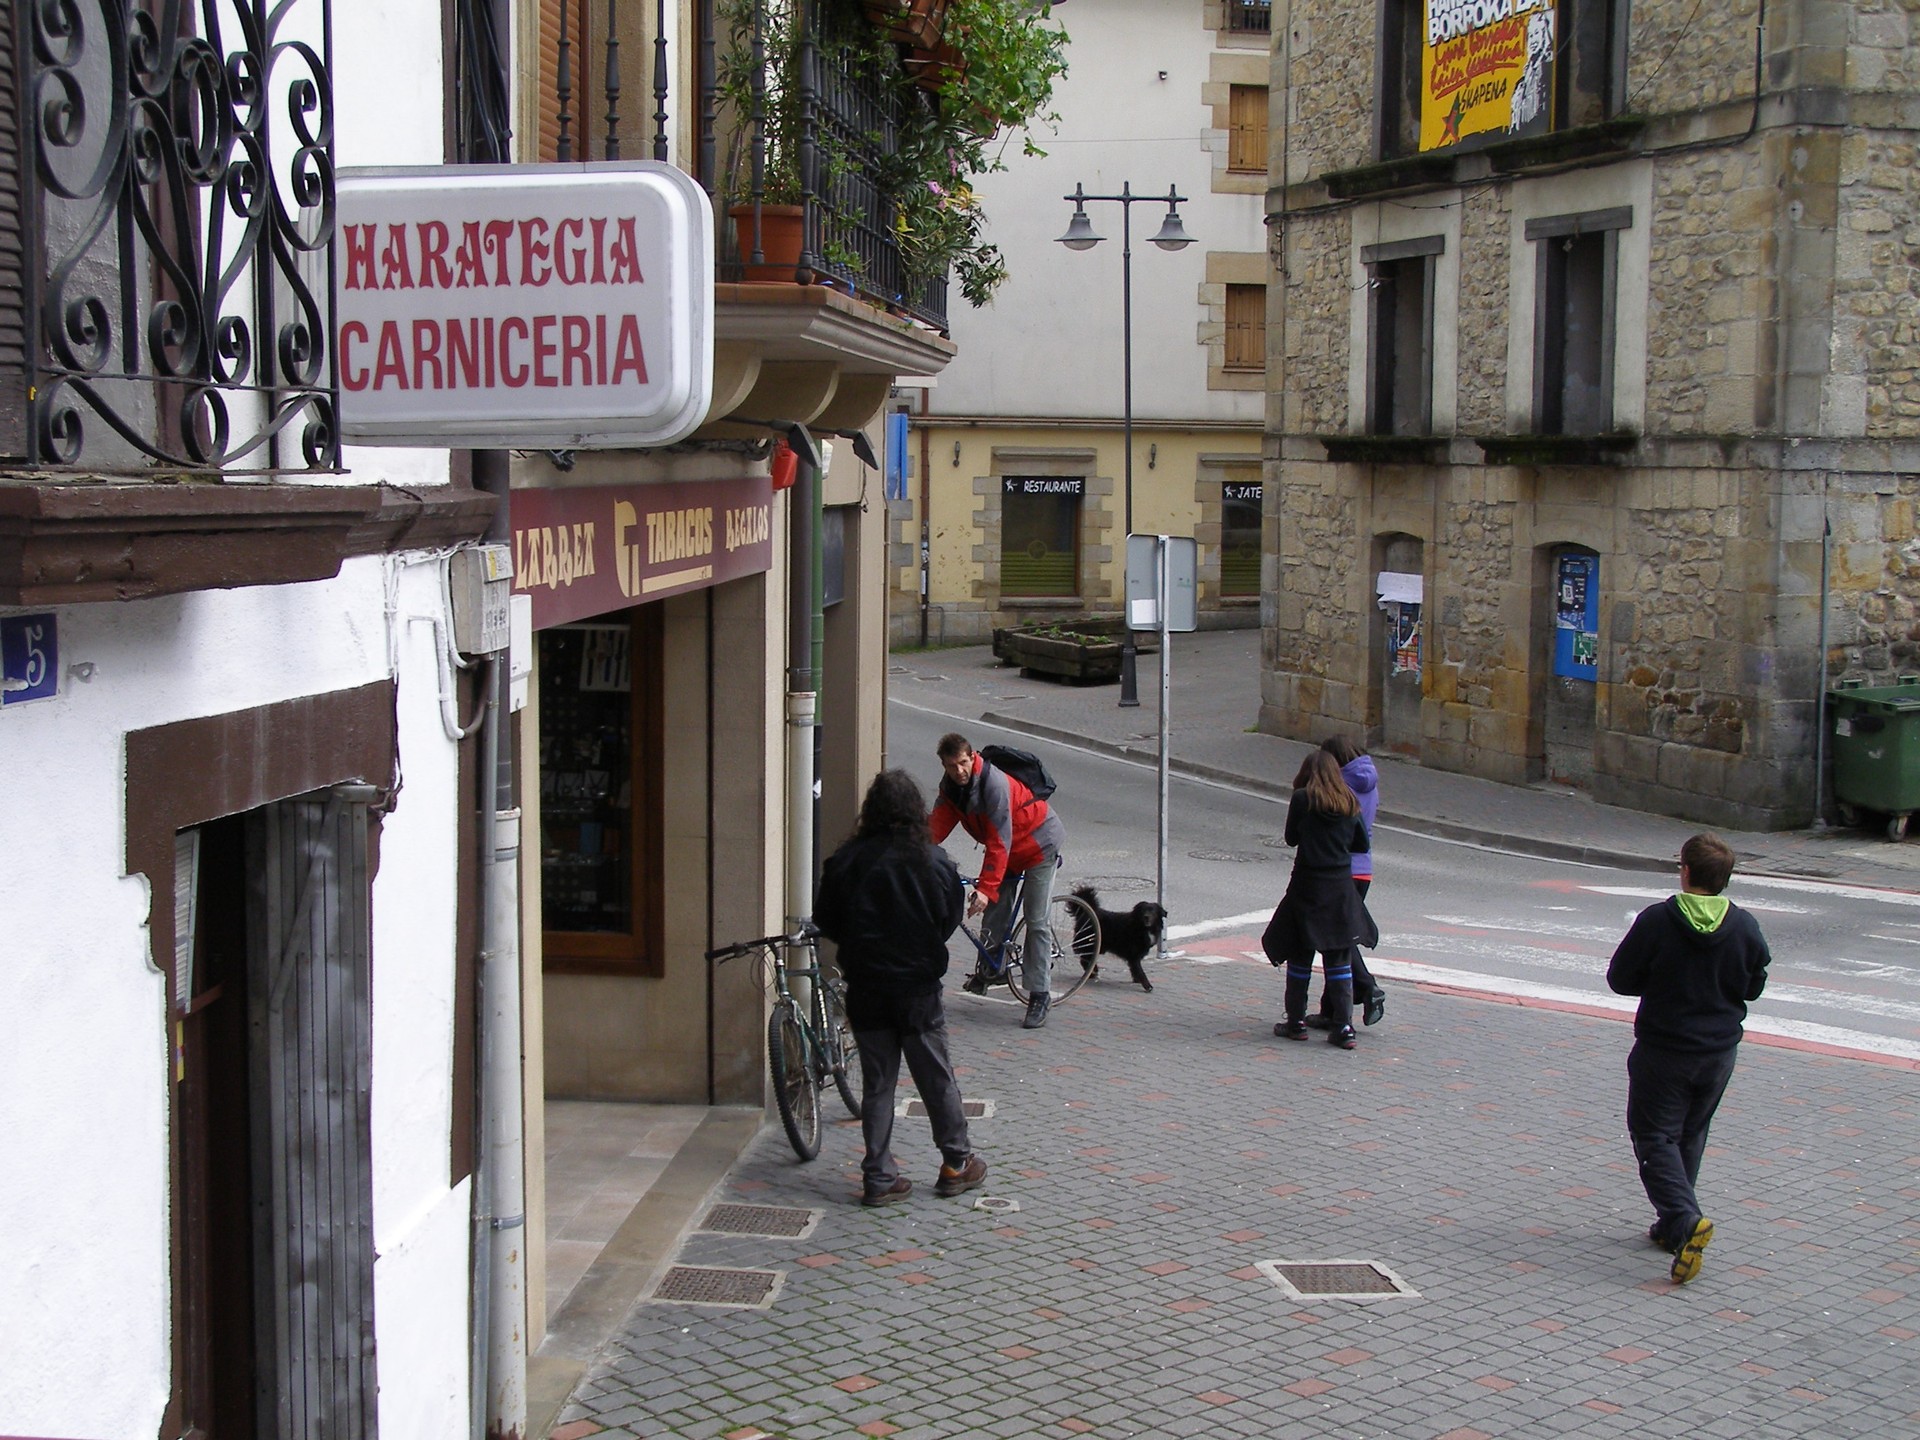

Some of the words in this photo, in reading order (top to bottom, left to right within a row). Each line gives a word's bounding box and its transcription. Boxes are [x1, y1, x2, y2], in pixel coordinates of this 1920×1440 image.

[343, 216, 644, 290] HARATEGIA
[340, 314, 649, 392] CARNICERIA
[1023, 479, 1081, 493] RESTAURANTE
[1237, 486, 1262, 499] JATE
[515, 522, 595, 590] LARREA
[646, 507, 713, 564] TABACOS
[725, 504, 768, 552] REGALOS
[25, 624, 46, 687] 5
